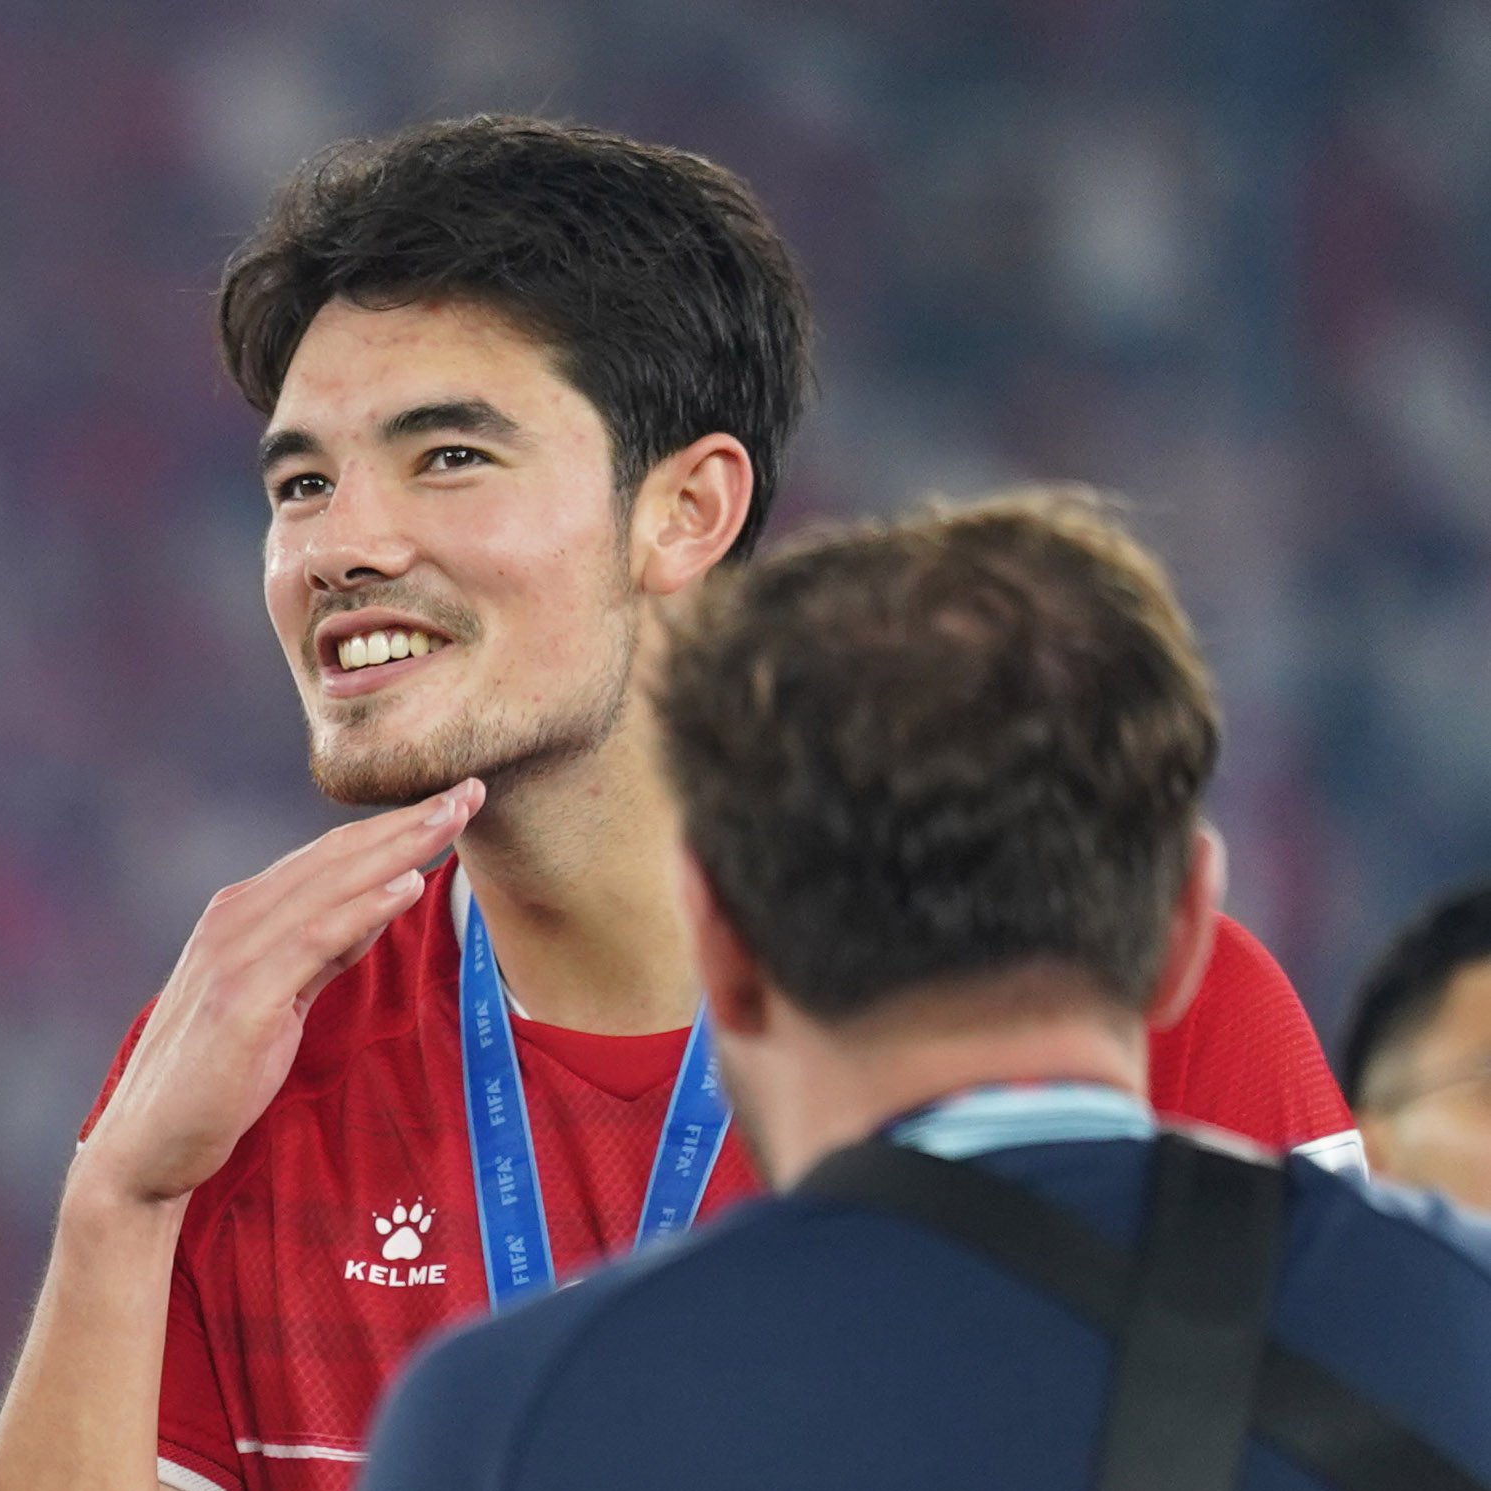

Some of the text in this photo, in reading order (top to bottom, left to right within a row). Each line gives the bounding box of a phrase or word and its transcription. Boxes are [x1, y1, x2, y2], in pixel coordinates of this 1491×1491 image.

[475, 1000, 494, 1049] FIFA
[485, 1080, 506, 1128] FIFA
[674, 1124, 704, 1178] FIFA
[500, 1156, 518, 1206] FIFA
[344, 1259, 447, 1288] KELME
[512, 1235, 530, 1287] FIFA
